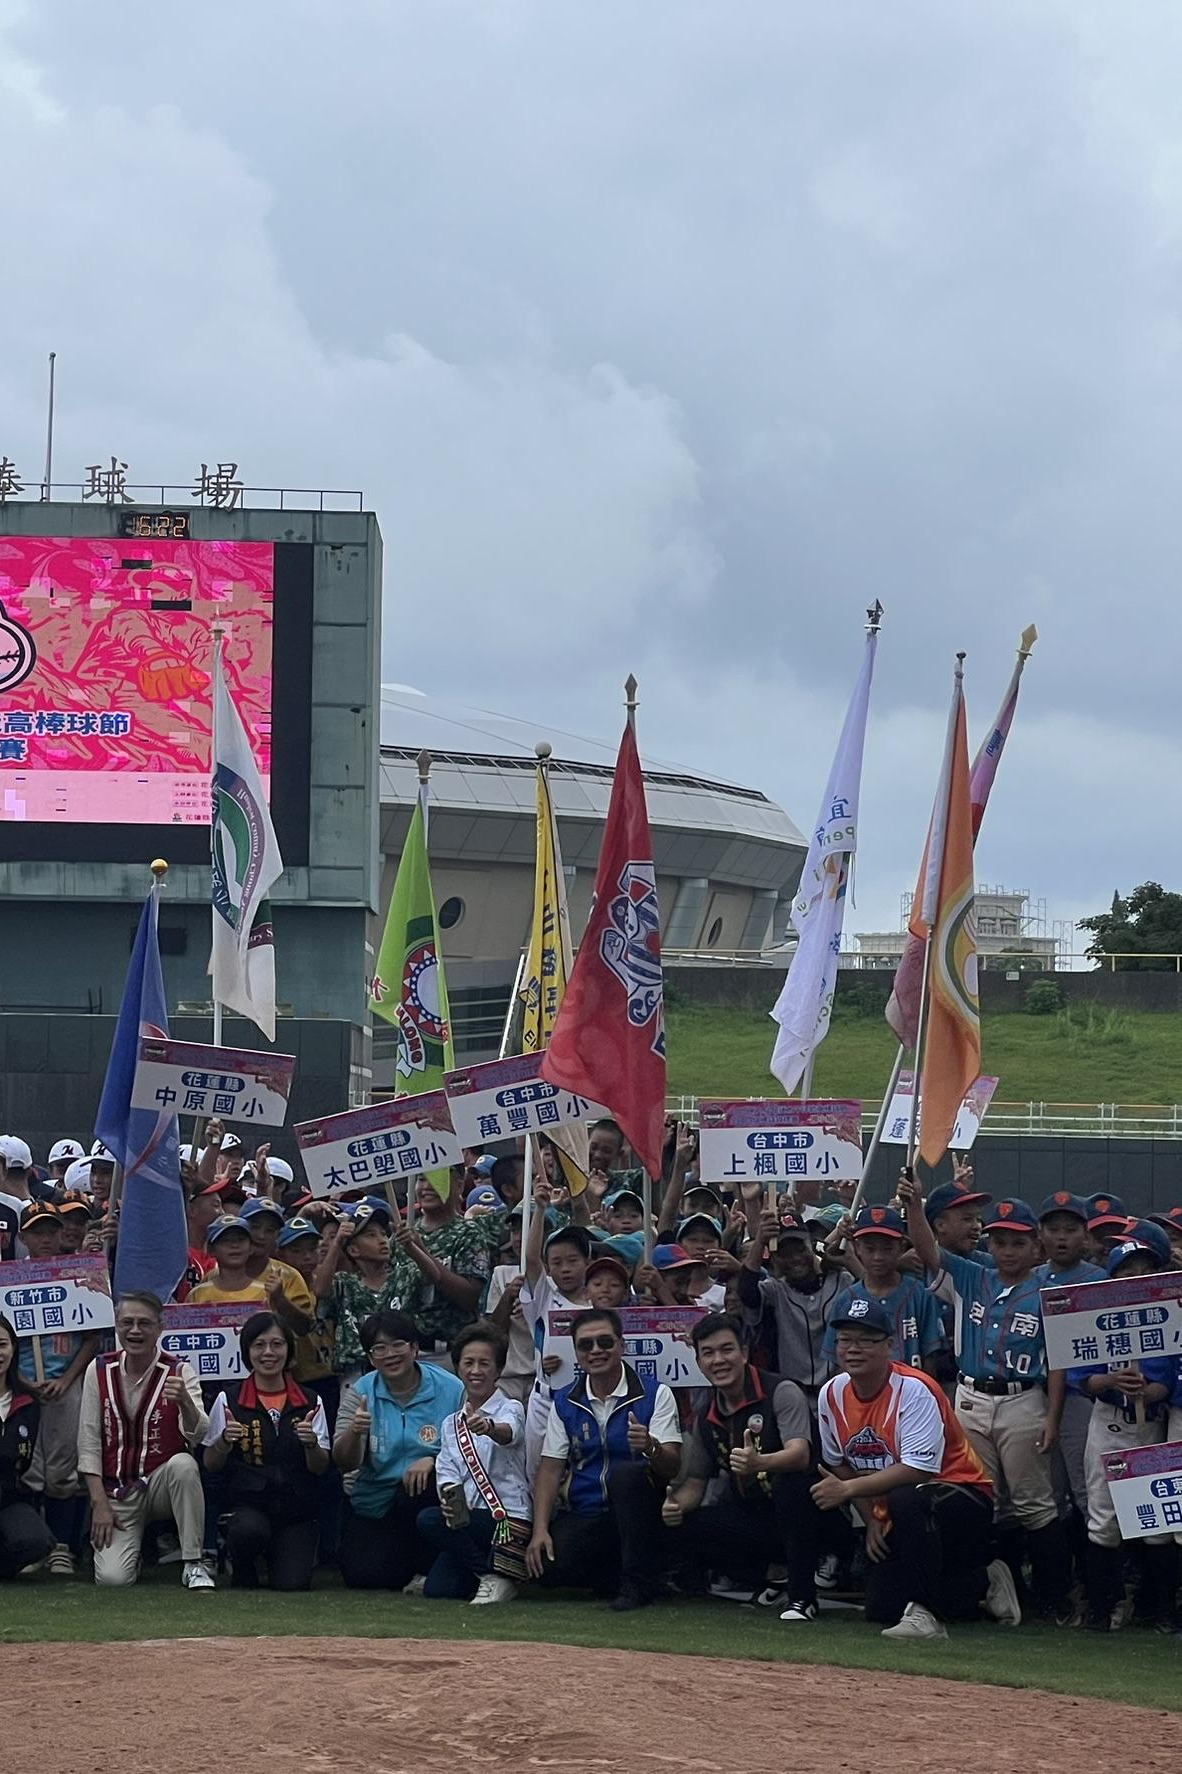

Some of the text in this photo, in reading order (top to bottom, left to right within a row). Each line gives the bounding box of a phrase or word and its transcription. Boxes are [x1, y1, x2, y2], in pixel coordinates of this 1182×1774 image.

[187, 1071, 241, 1092] 花蓮縣
[155, 1086, 264, 1118] 中原國小
[501, 1083, 555, 1107] 台中市
[477, 1095, 590, 1139] 萬豐國小
[351, 1132, 407, 1156] 花蓮縣
[753, 1133, 808, 1148] 台中市
[723, 1151, 840, 1176] 上楓國小
[9, 1288, 63, 1305] 新竹市
[1, 1303, 94, 1331] 園國小
[1101, 1307, 1164, 1330] 花蓮縣
[168, 1335, 220, 1350] 台中市
